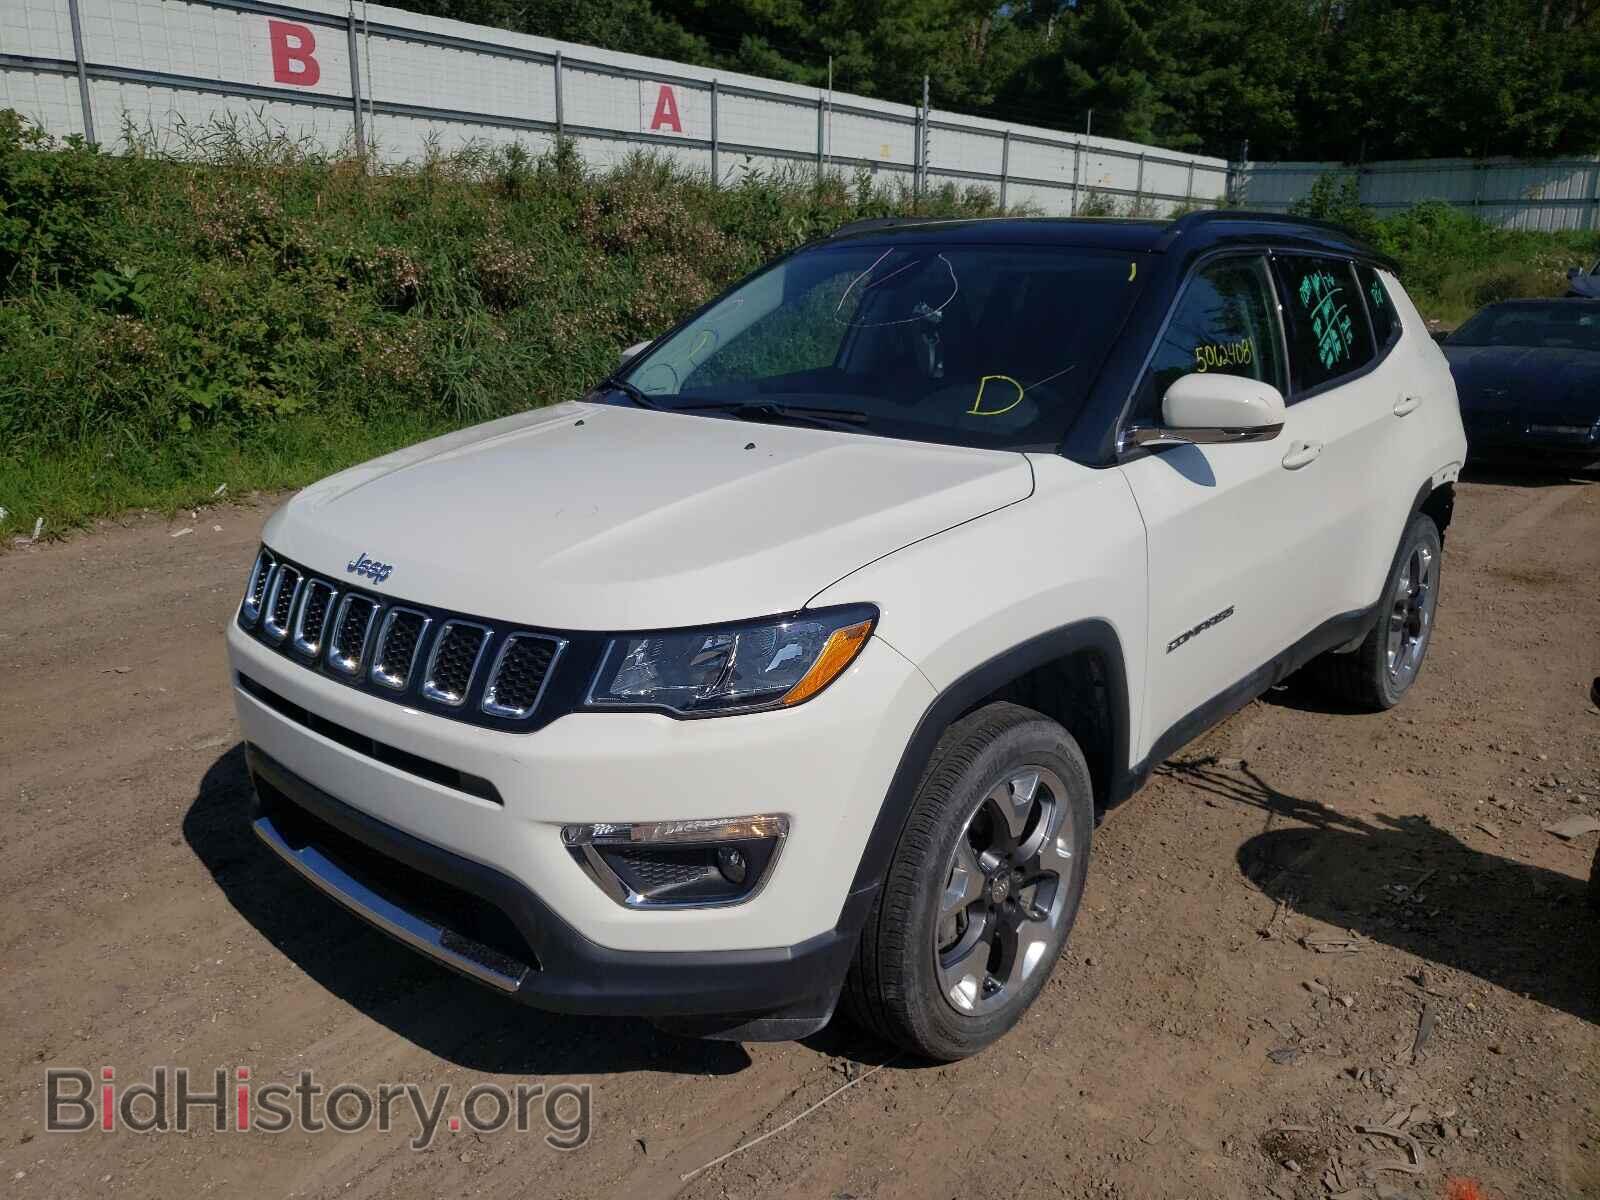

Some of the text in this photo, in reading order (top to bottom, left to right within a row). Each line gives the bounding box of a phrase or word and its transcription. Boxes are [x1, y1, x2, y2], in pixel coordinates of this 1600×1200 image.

[268, 19, 320, 87] B
[651, 85, 682, 133] A
[965, 375, 1024, 416] D
[347, 552, 392, 585] Jeep
